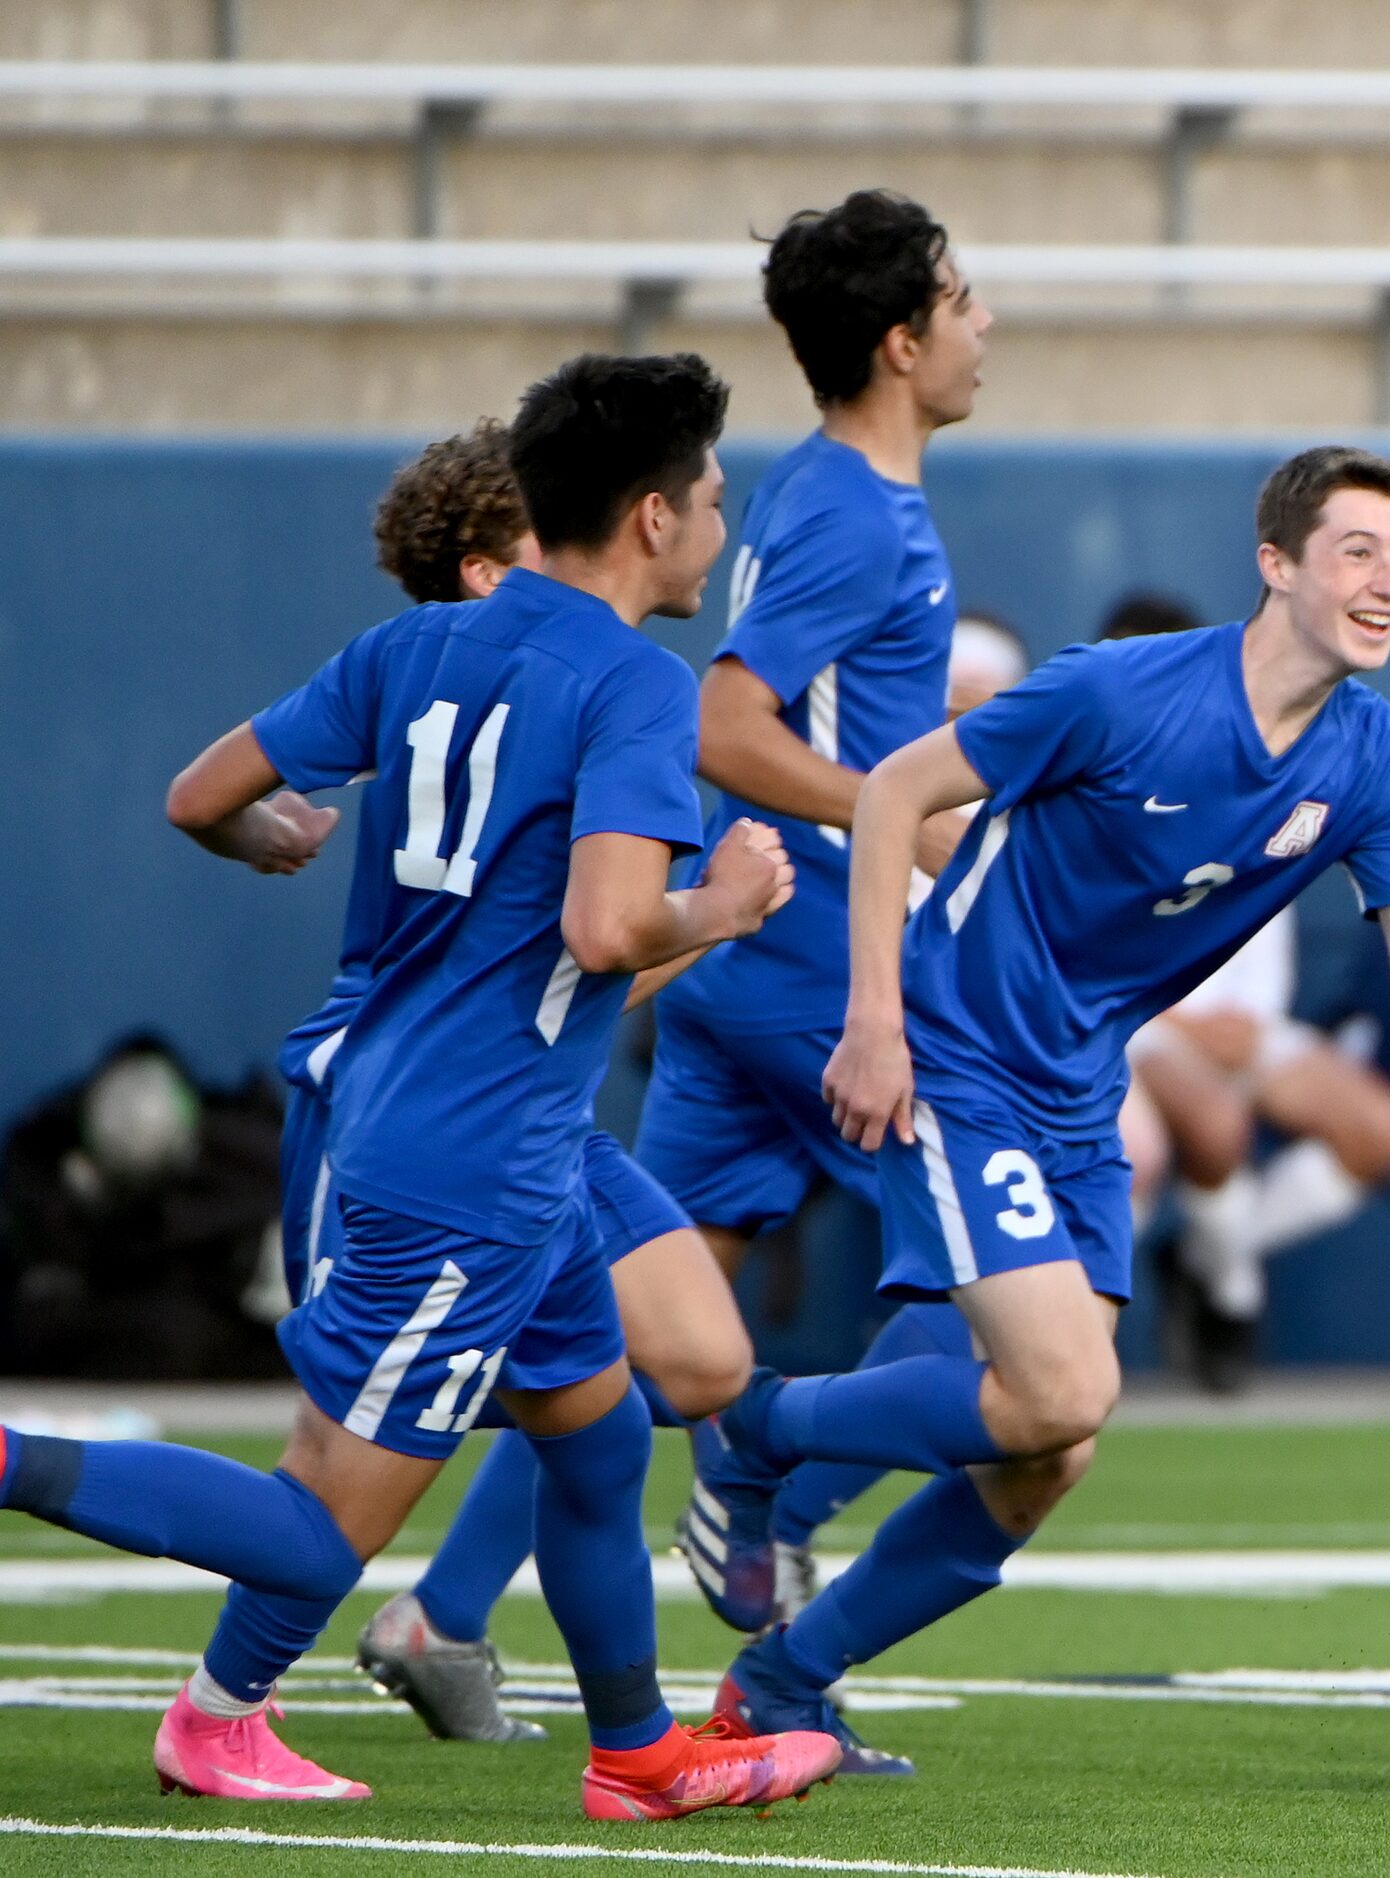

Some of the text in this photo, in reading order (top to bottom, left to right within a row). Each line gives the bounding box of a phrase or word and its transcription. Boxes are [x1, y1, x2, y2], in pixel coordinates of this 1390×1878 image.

[393, 700, 511, 898] 11
[1263, 799, 1330, 859] A
[1152, 862, 1234, 917] 3
[982, 1149, 1056, 1241] 3
[415, 1346, 508, 1433] 11
